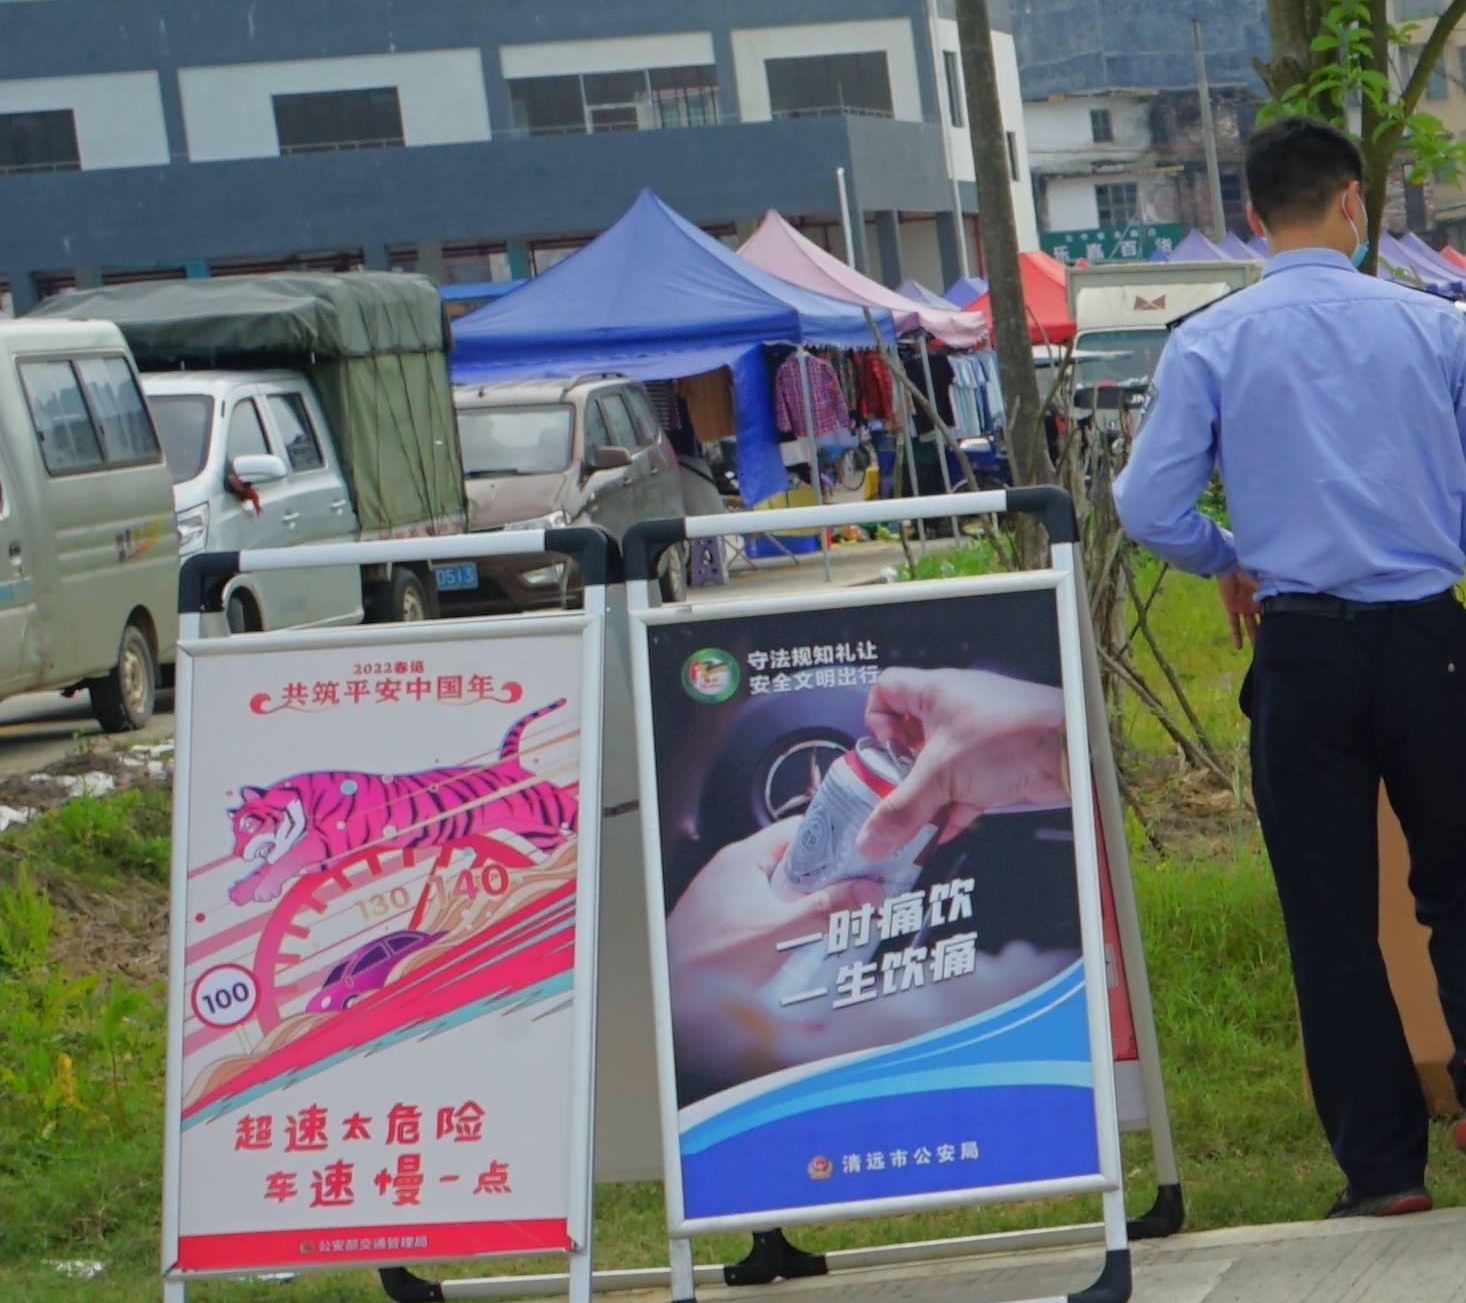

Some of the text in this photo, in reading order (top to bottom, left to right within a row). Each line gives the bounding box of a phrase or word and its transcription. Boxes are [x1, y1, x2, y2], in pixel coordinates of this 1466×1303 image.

[747, 641, 879, 671] 守法规知礼让
[281, 674, 495, 706] 共筑平安中国年
[749, 665, 881, 695] 安全文明出行
[353, 864, 510, 922] 130 140
[776, 877, 976, 956] 一时痛饮
[780, 931, 979, 1010] 一生饮痛
[202, 981, 250, 1015] 100
[234, 1099, 486, 1153] 超速太危险
[841, 1140, 980, 1174] 清远市公安局
[263, 1152, 513, 1209] 车速慢一点
[318, 1236, 428, 1253] 公安部交通管理局
